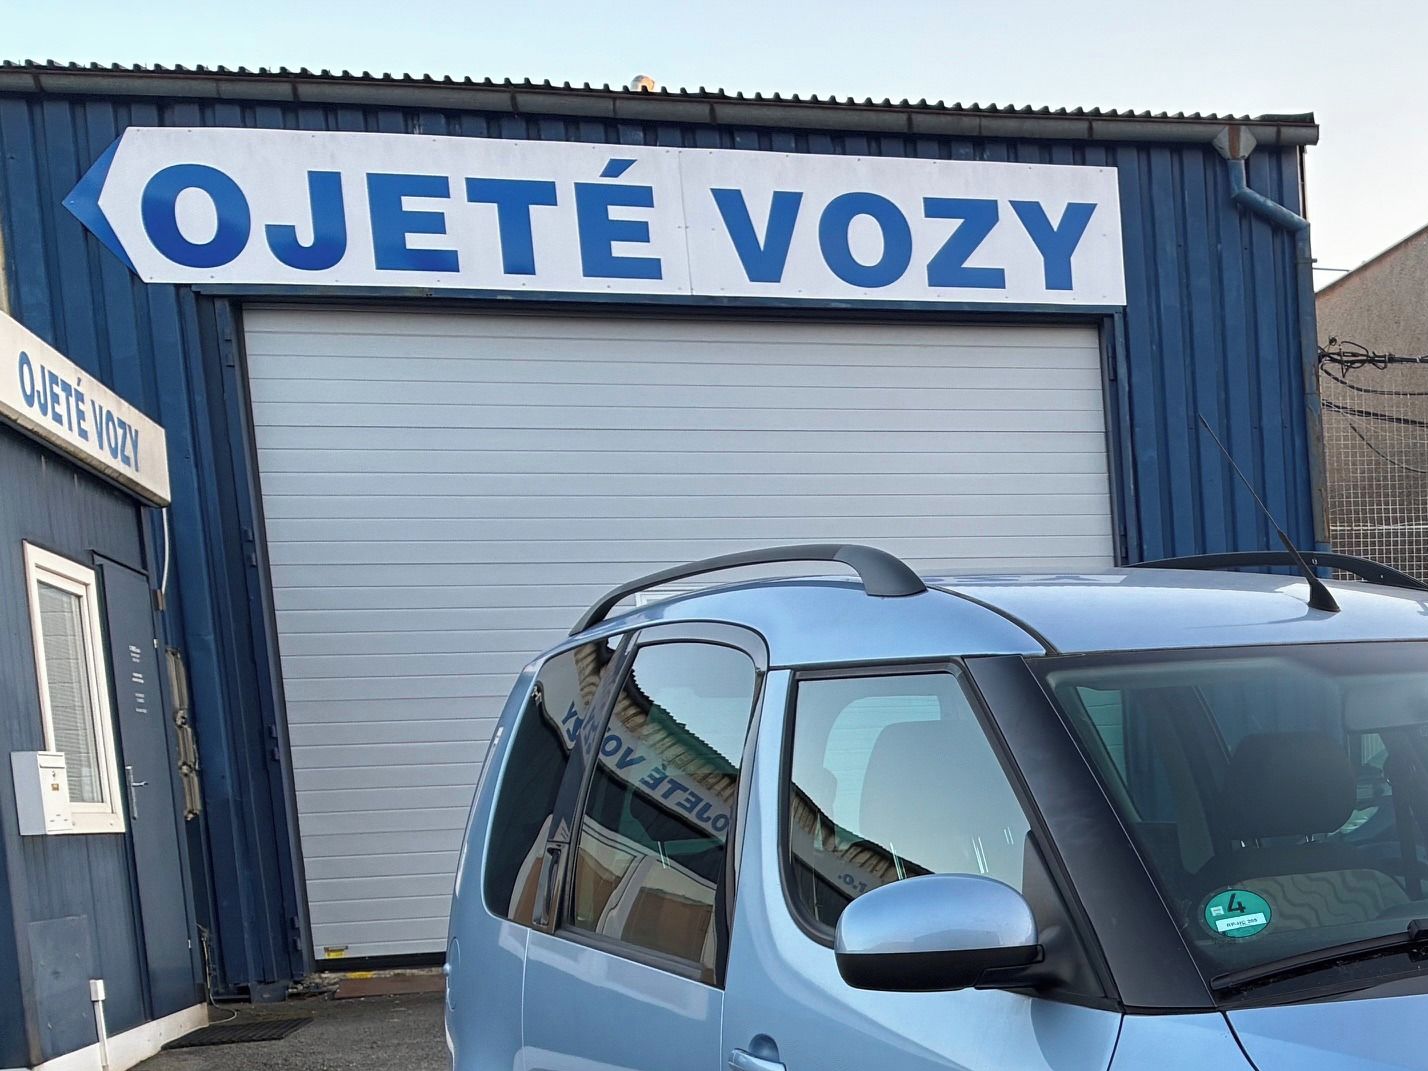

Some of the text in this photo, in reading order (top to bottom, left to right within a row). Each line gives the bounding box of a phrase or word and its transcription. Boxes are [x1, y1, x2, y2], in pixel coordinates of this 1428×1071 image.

[141, 159, 1097, 290] OJETÉ VOZY
[18, 351, 140, 472] OJETÉ VOZY
[1227, 893, 1247, 913] 4
